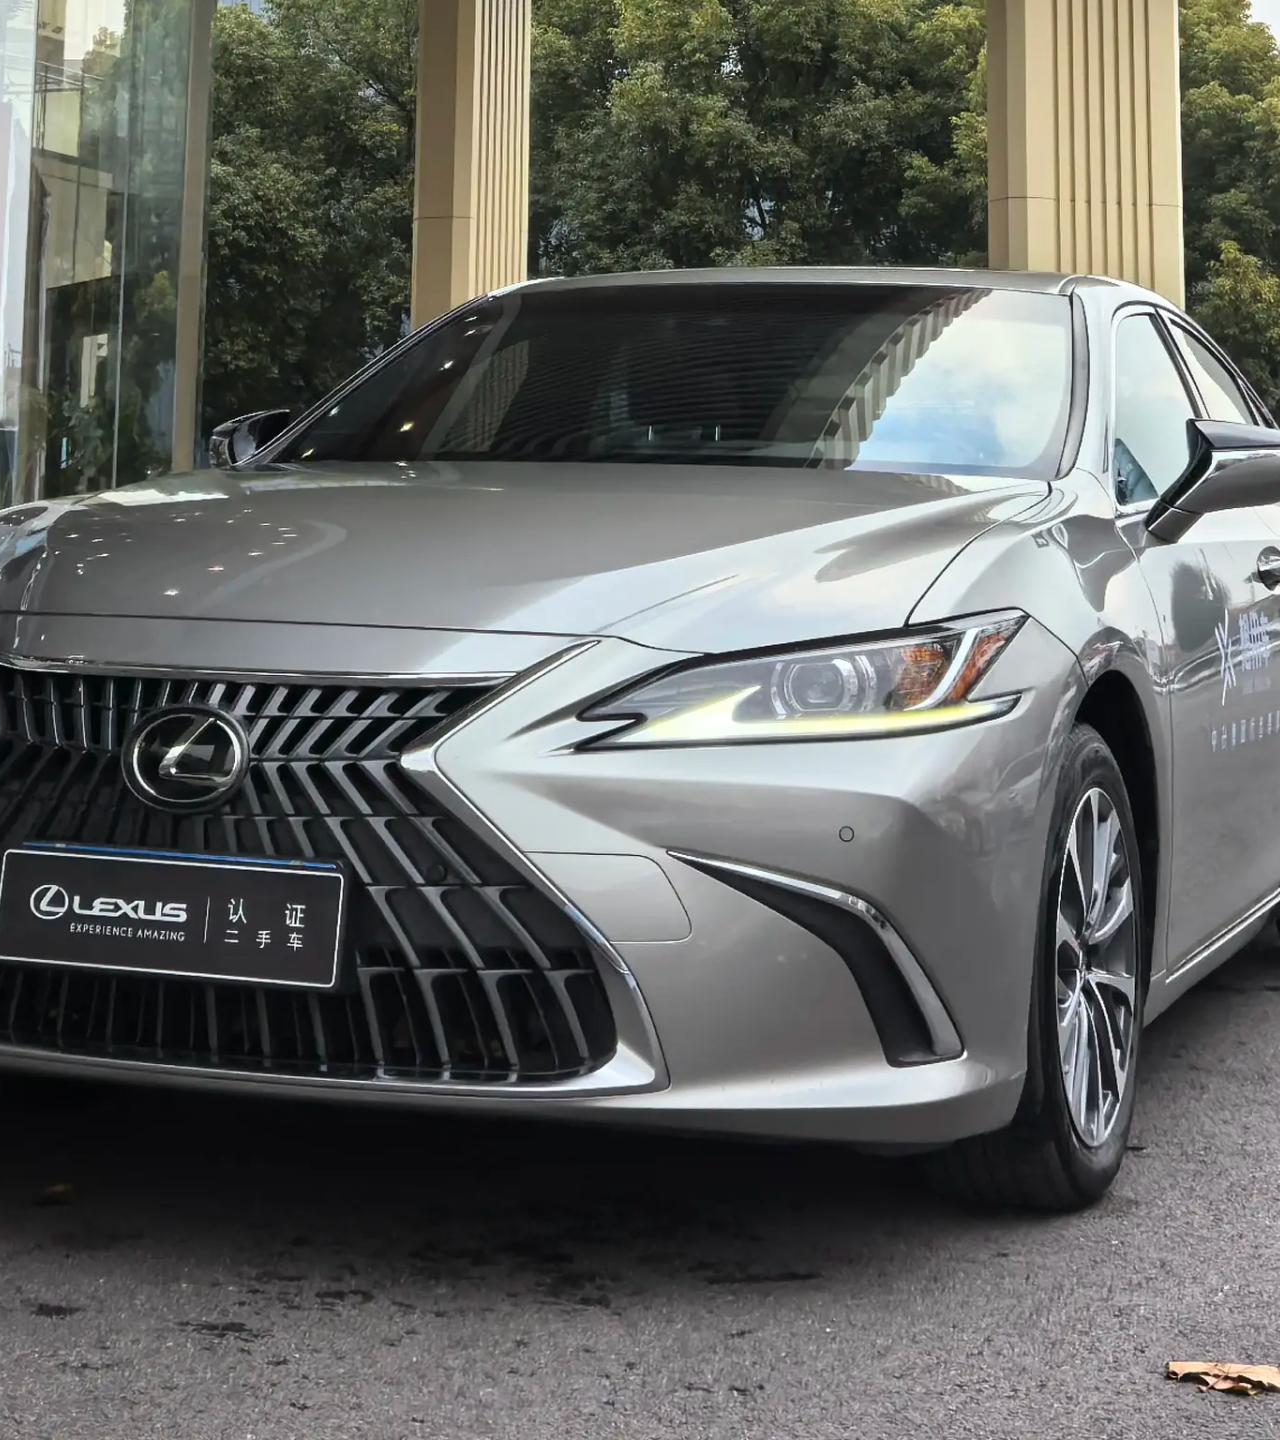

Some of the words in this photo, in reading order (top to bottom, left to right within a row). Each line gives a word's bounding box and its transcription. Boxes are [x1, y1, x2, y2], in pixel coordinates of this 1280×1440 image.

[72, 895, 188, 922] LEXUS
[227, 897, 307, 928] 认证
[69, 922, 133, 938] EXPERIENCE
[136, 928, 186, 942] AMAZING
[224, 929, 304, 952] 二手车
